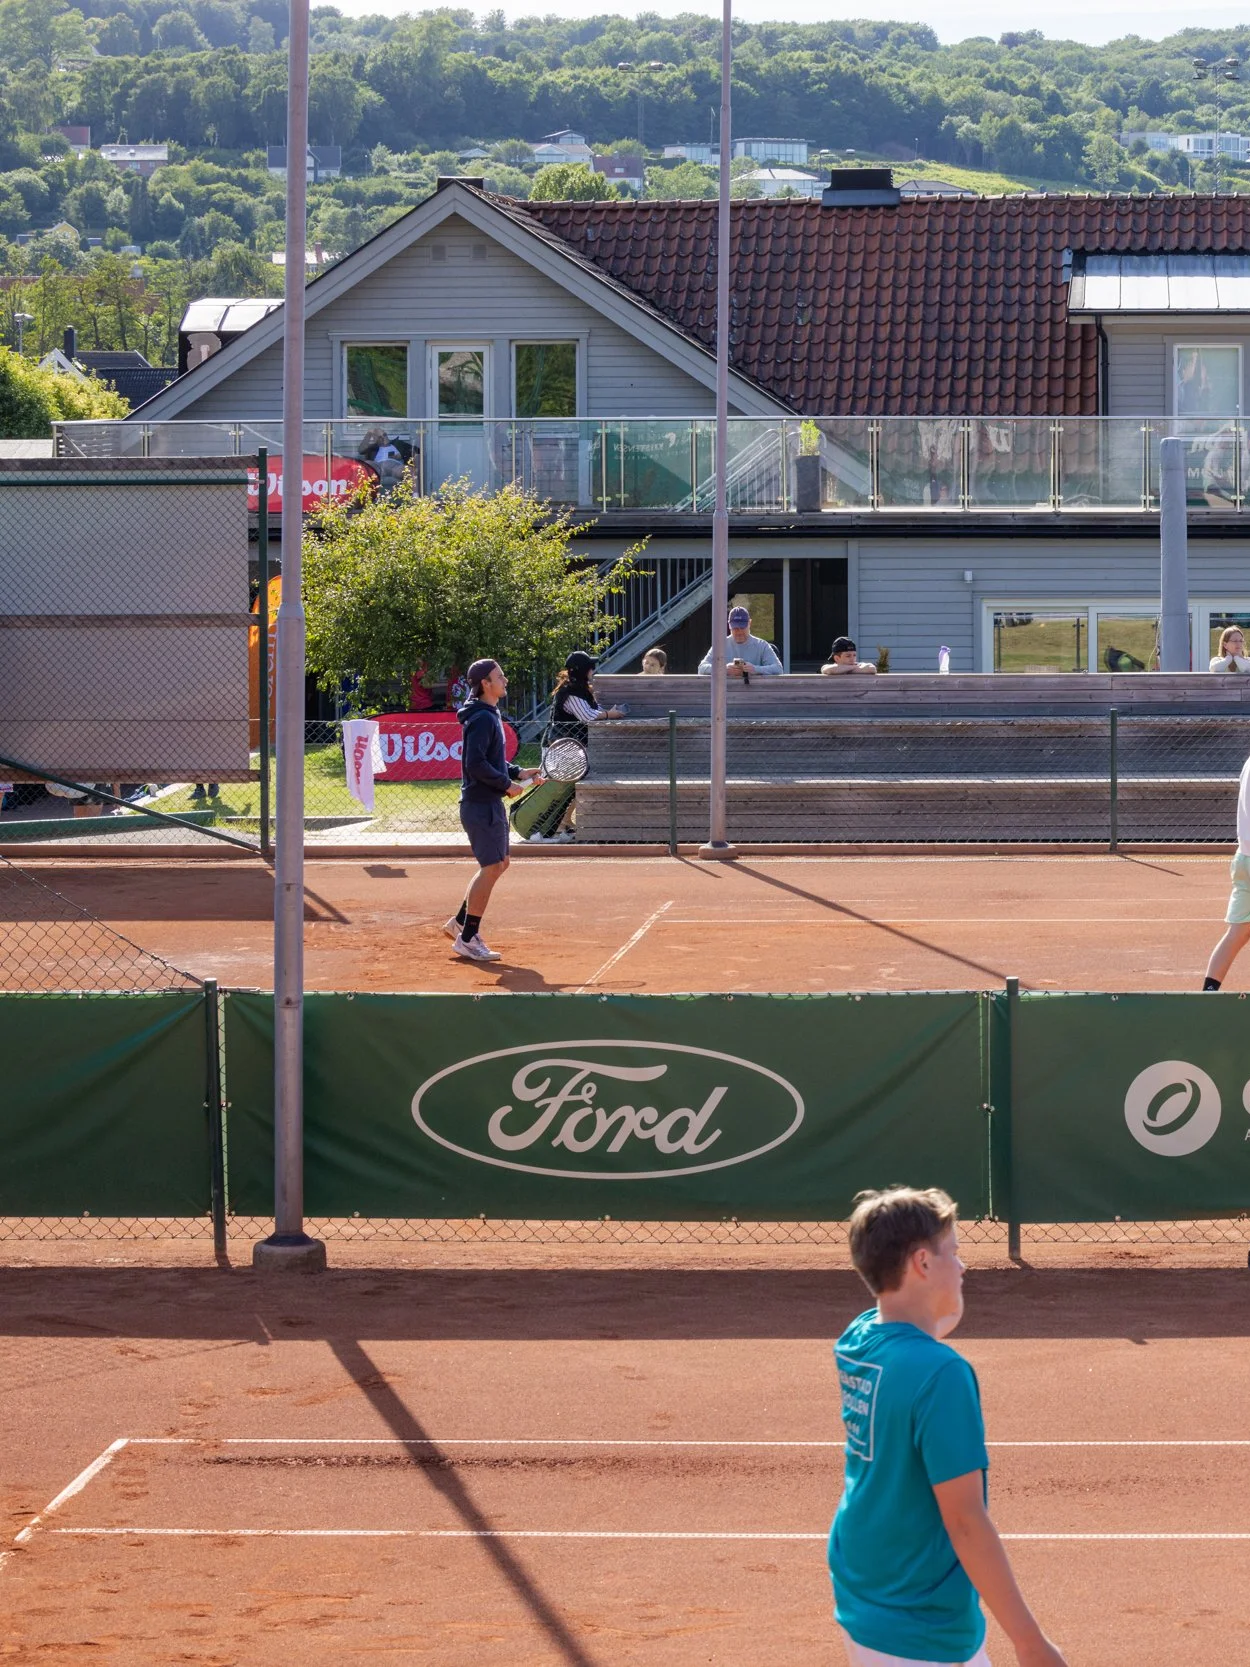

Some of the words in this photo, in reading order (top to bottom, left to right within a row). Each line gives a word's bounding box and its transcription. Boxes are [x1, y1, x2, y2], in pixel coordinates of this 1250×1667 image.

[247, 472, 347, 497] Wison
[379, 731, 464, 763] Wilso
[488, 1058, 729, 1155] Ford
